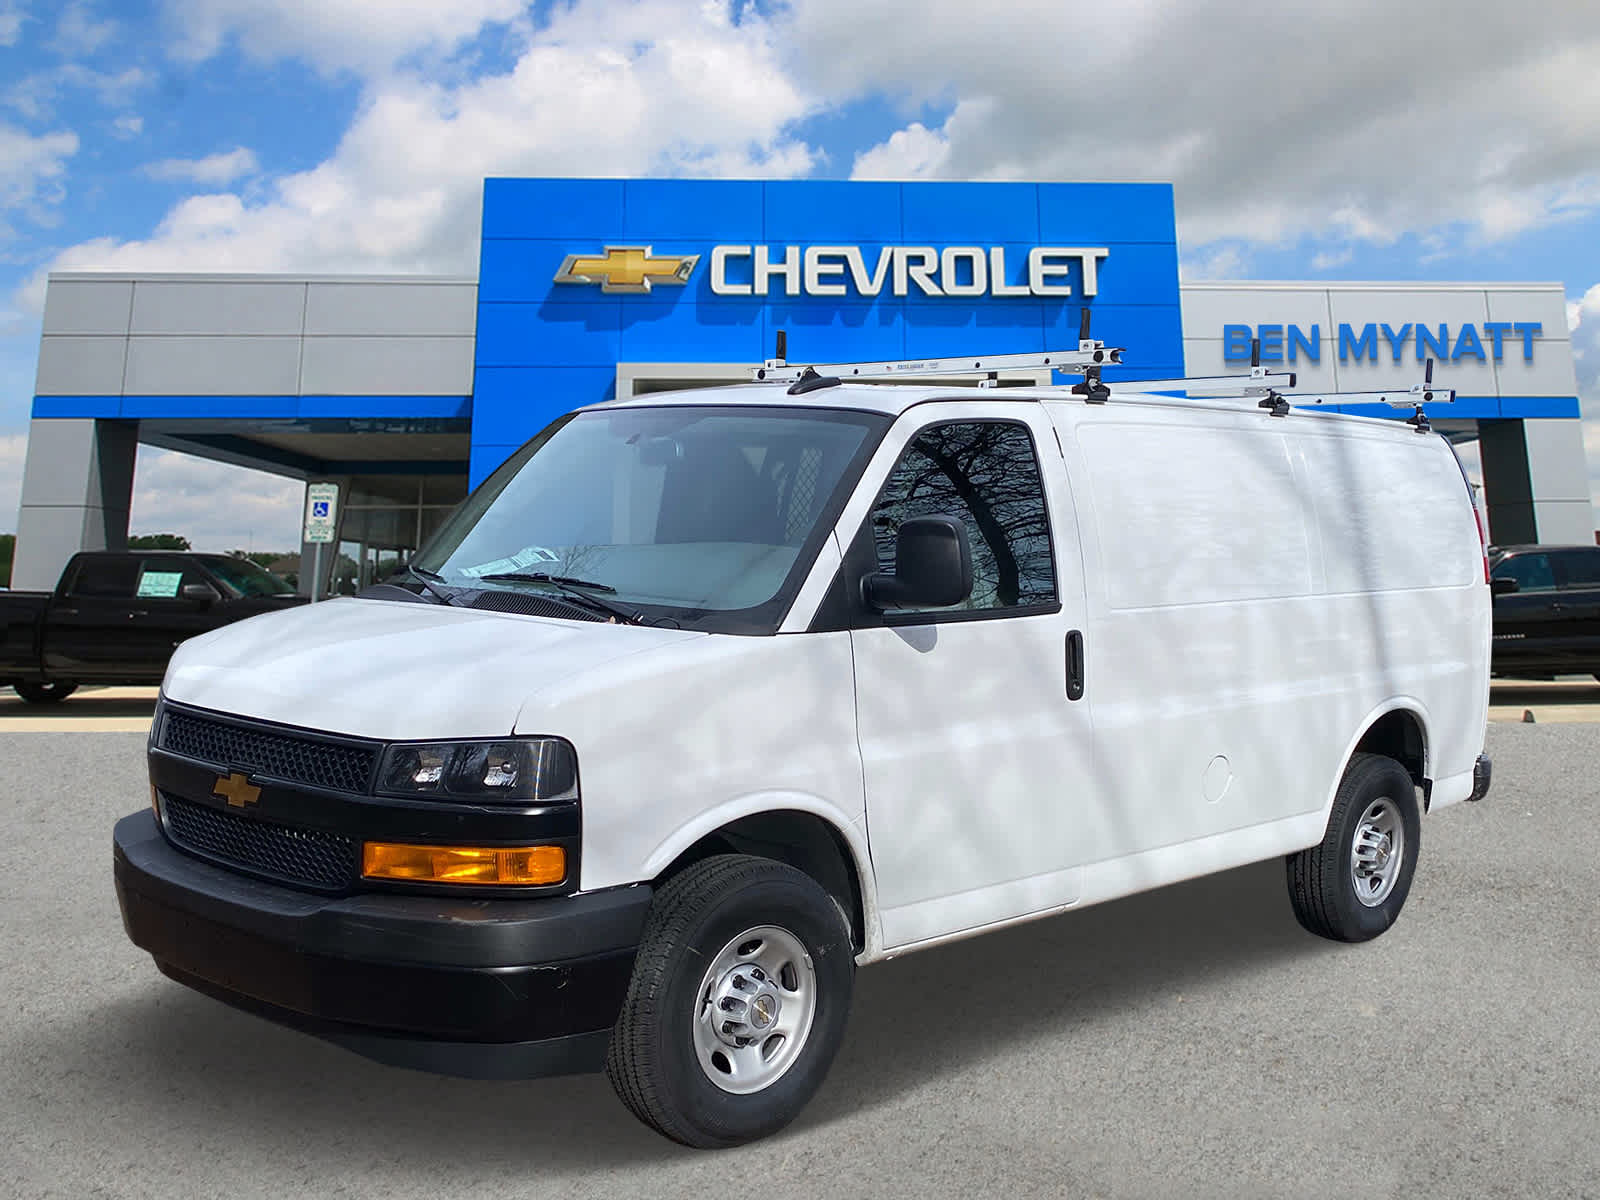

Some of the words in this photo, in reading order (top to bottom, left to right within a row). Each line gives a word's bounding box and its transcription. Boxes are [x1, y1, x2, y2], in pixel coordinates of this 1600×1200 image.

[710, 245, 1109, 297] CHEVROLET
[1223, 324, 1320, 362] BEN
[1338, 322, 1543, 362] MYNATT
